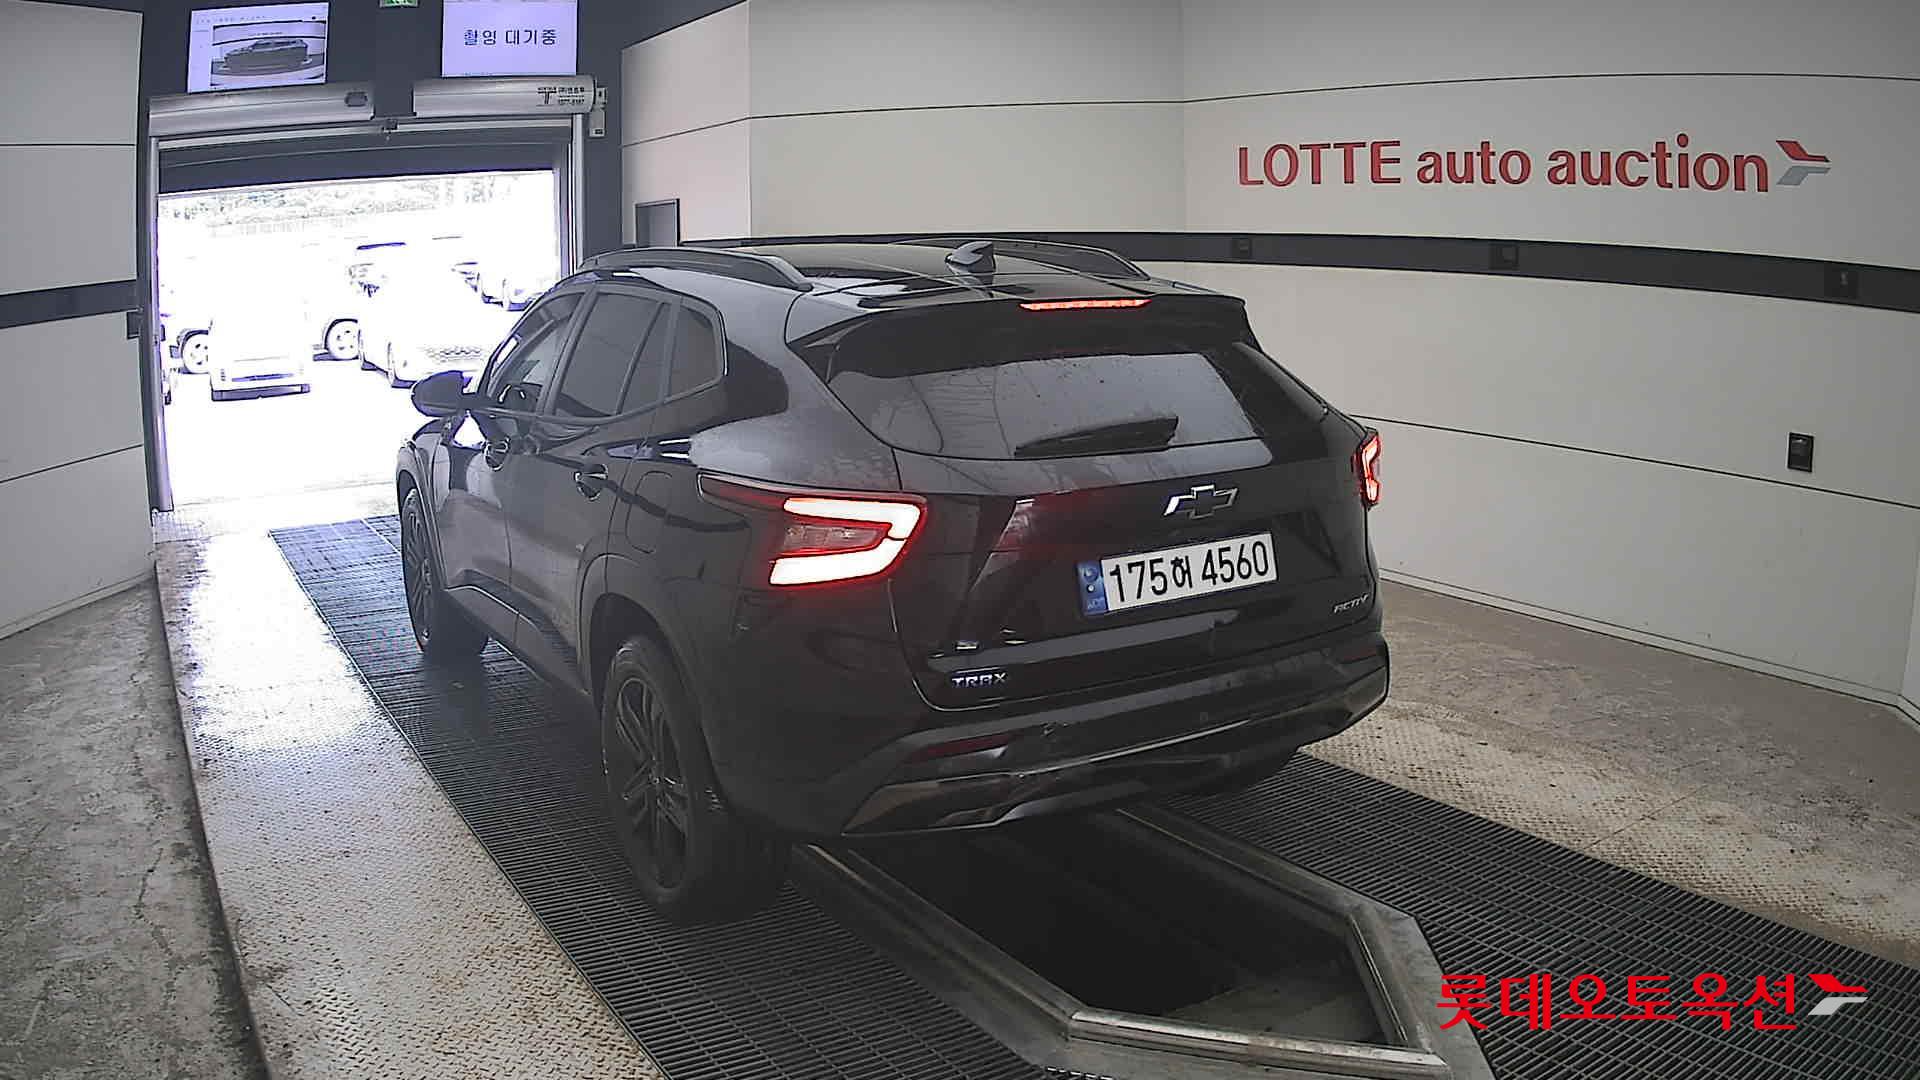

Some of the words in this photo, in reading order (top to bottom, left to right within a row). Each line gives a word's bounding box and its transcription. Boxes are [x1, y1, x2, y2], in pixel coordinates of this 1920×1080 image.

[505, 28, 557, 46] 대기중
[1238, 140, 1402, 187] LOTTE
[1416, 141, 1532, 185] auto
[1547, 133, 1769, 193] auction
[1109, 556, 1193, 602] 175허
[1201, 542, 1269, 585] 4560
